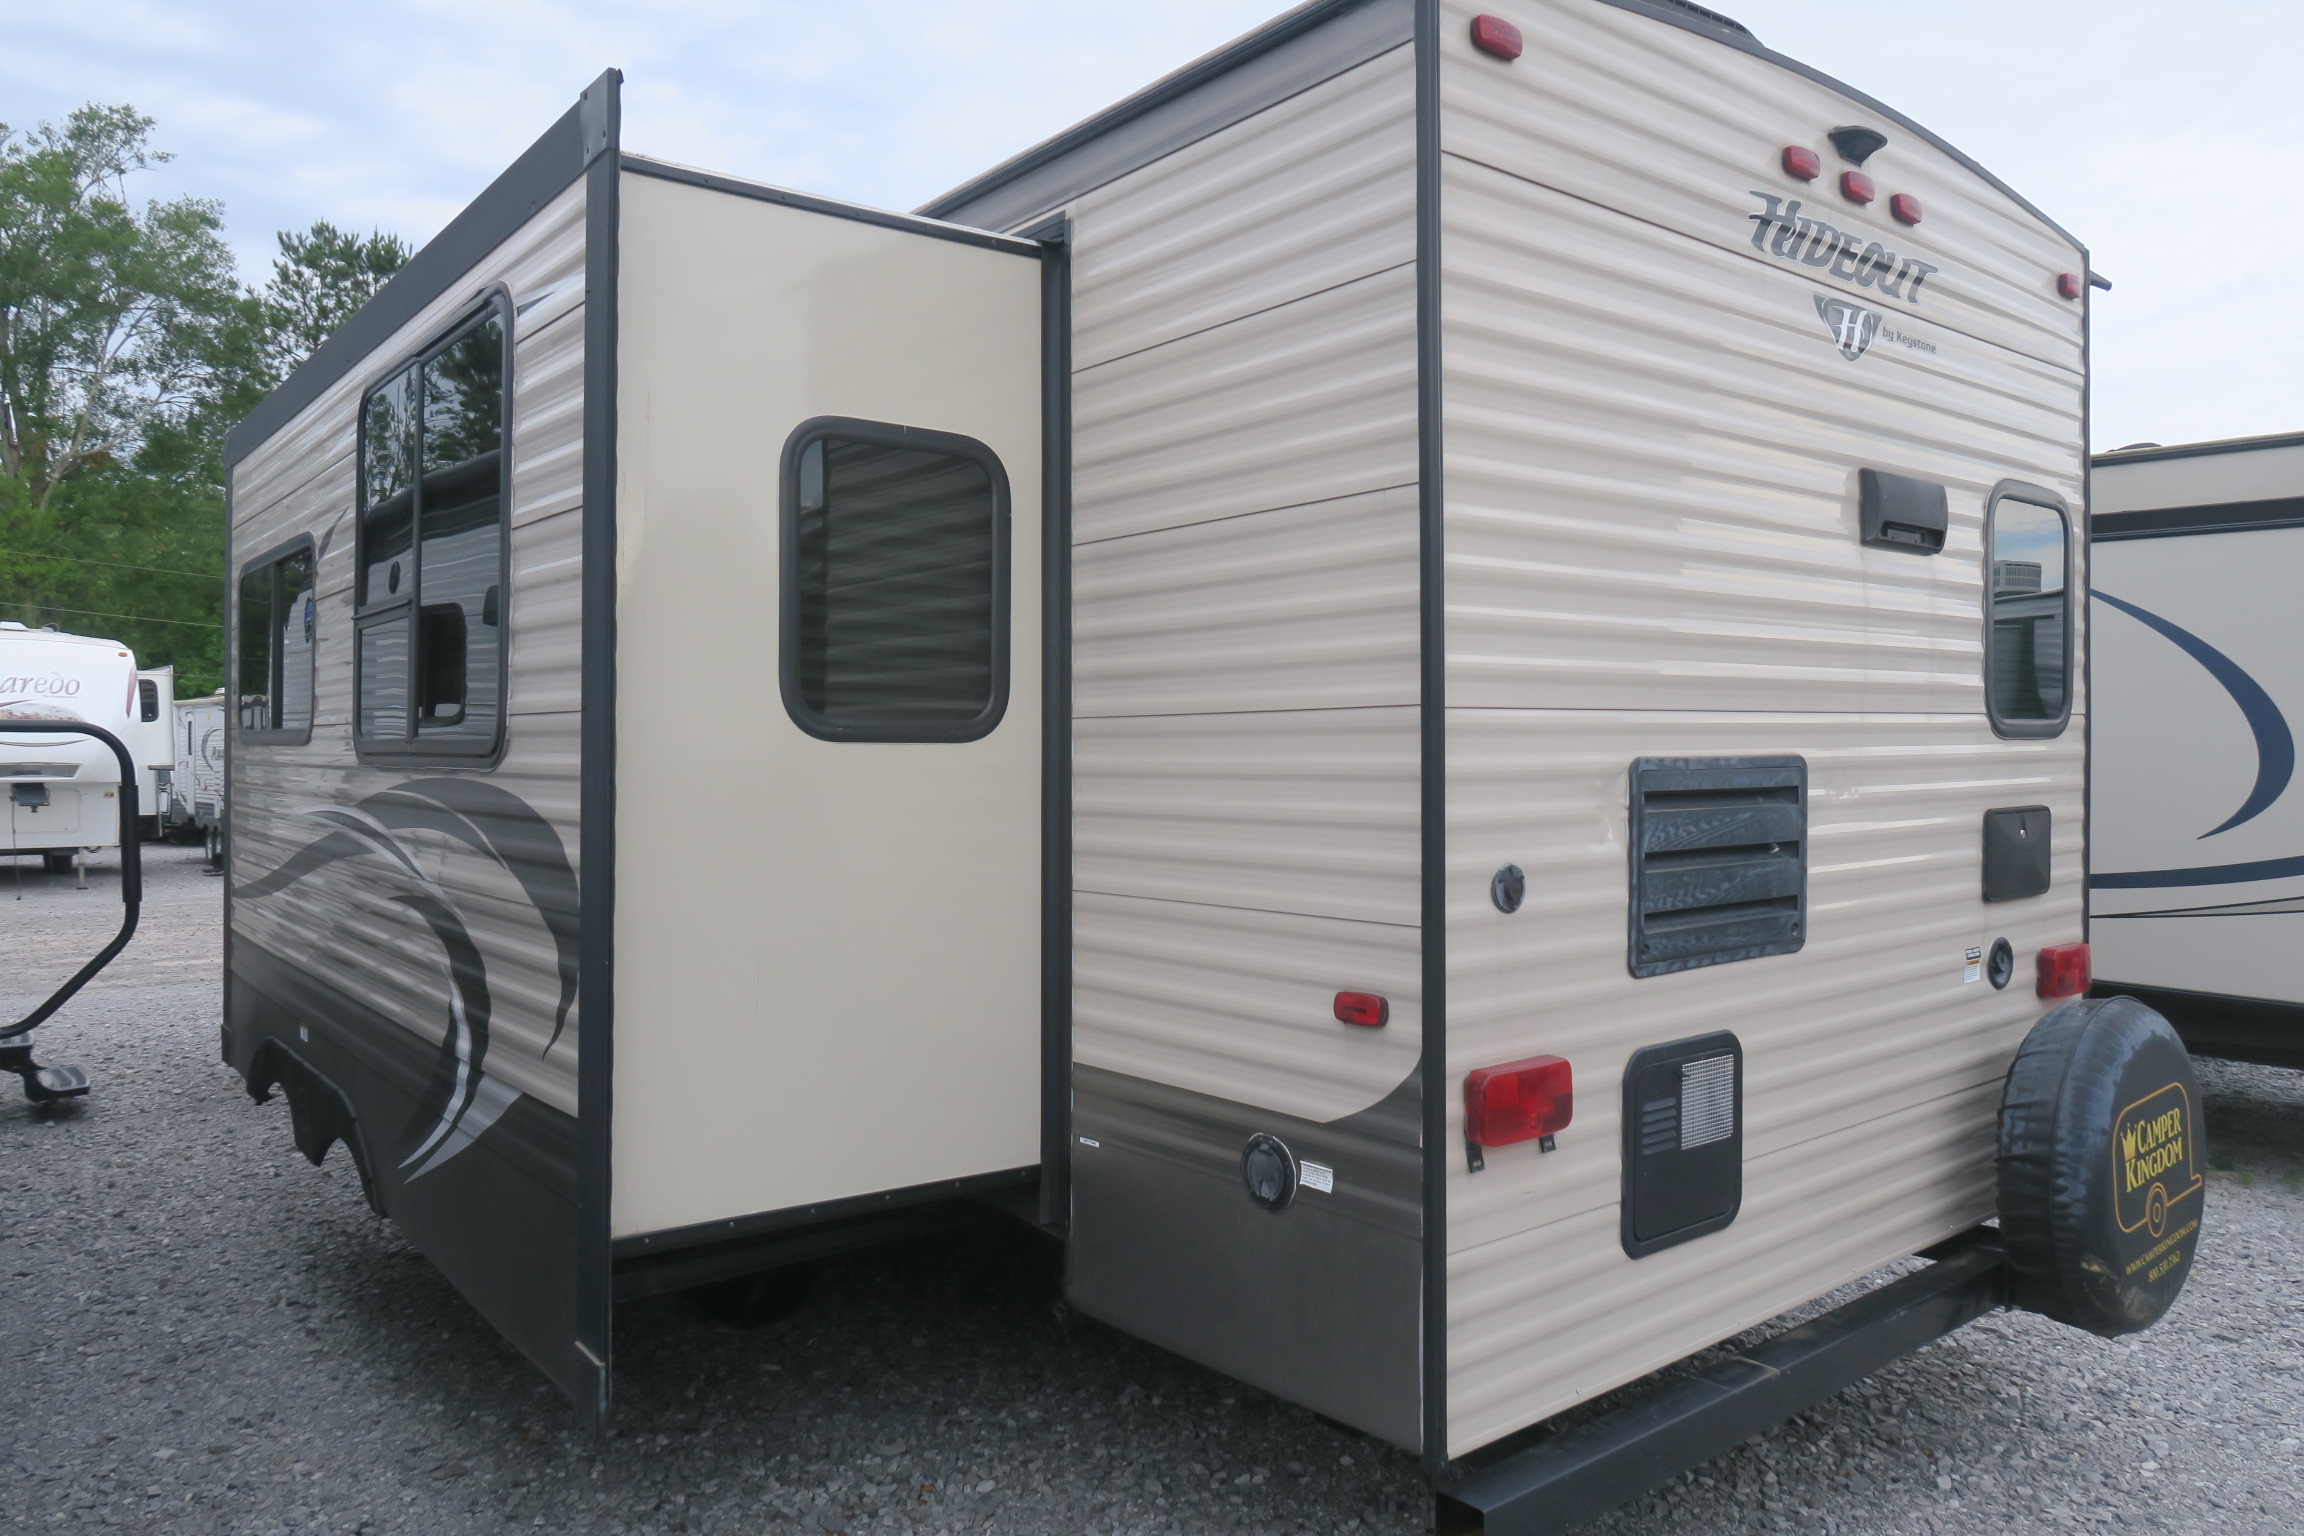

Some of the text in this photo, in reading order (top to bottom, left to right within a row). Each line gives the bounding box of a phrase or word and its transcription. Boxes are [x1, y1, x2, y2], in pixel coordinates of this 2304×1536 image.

[1748, 189, 1939, 305] HIDEOUT
[1882, 326, 1936, 354] by Keystone
[0, 671, 81, 696] aredo
[2137, 1107, 2182, 1154] CAMPER
[2125, 1136, 2183, 1193] KINGDOM
